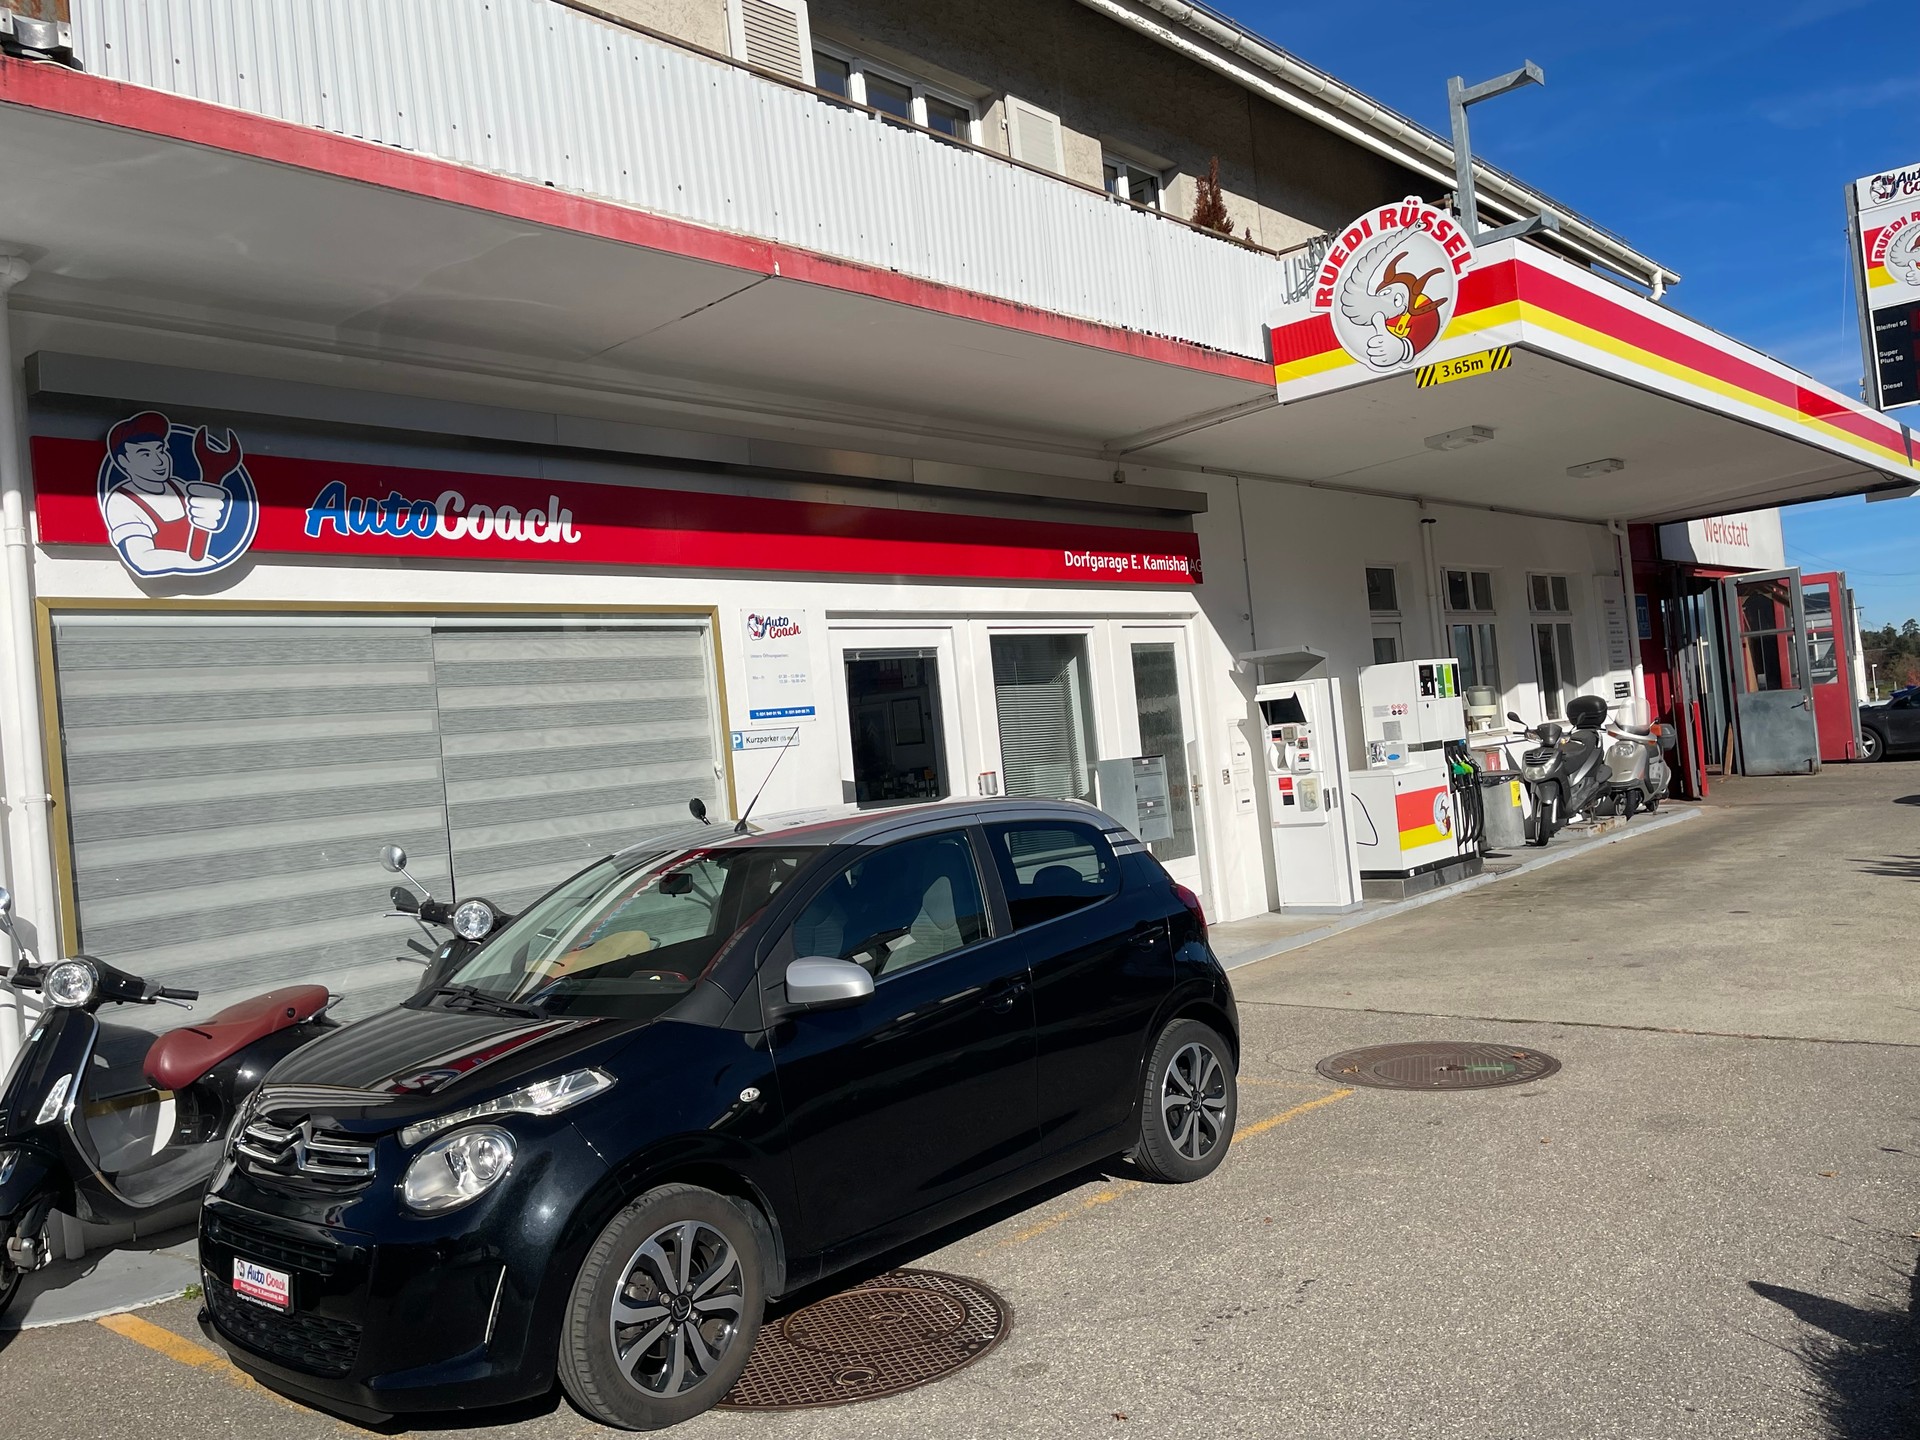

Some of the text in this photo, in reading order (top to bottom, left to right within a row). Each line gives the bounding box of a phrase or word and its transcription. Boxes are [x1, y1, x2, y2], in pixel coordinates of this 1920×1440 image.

[1874, 216, 1908, 260] RUEDI
[1315, 199, 1472, 308] RUEDI RÜSSEL
[1876, 319, 1908, 332] Bleifrei 95
[1879, 348, 1899, 358] Super
[1880, 356, 1895, 365] Plus
[1442, 358, 1485, 378] 3.65m
[1882, 381, 1904, 391] Diesel
[304, 480, 582, 544] AutoCoach
[1702, 516, 1750, 547] Werkstatt
[1064, 550, 1203, 575] Dorfgarage E. Kamishaj AG
[764, 616, 789, 631] Auto
[769, 622, 801, 640] Coach
[745, 734, 780, 745] Kurzparker
[247, 1264, 265, 1285] Auto
